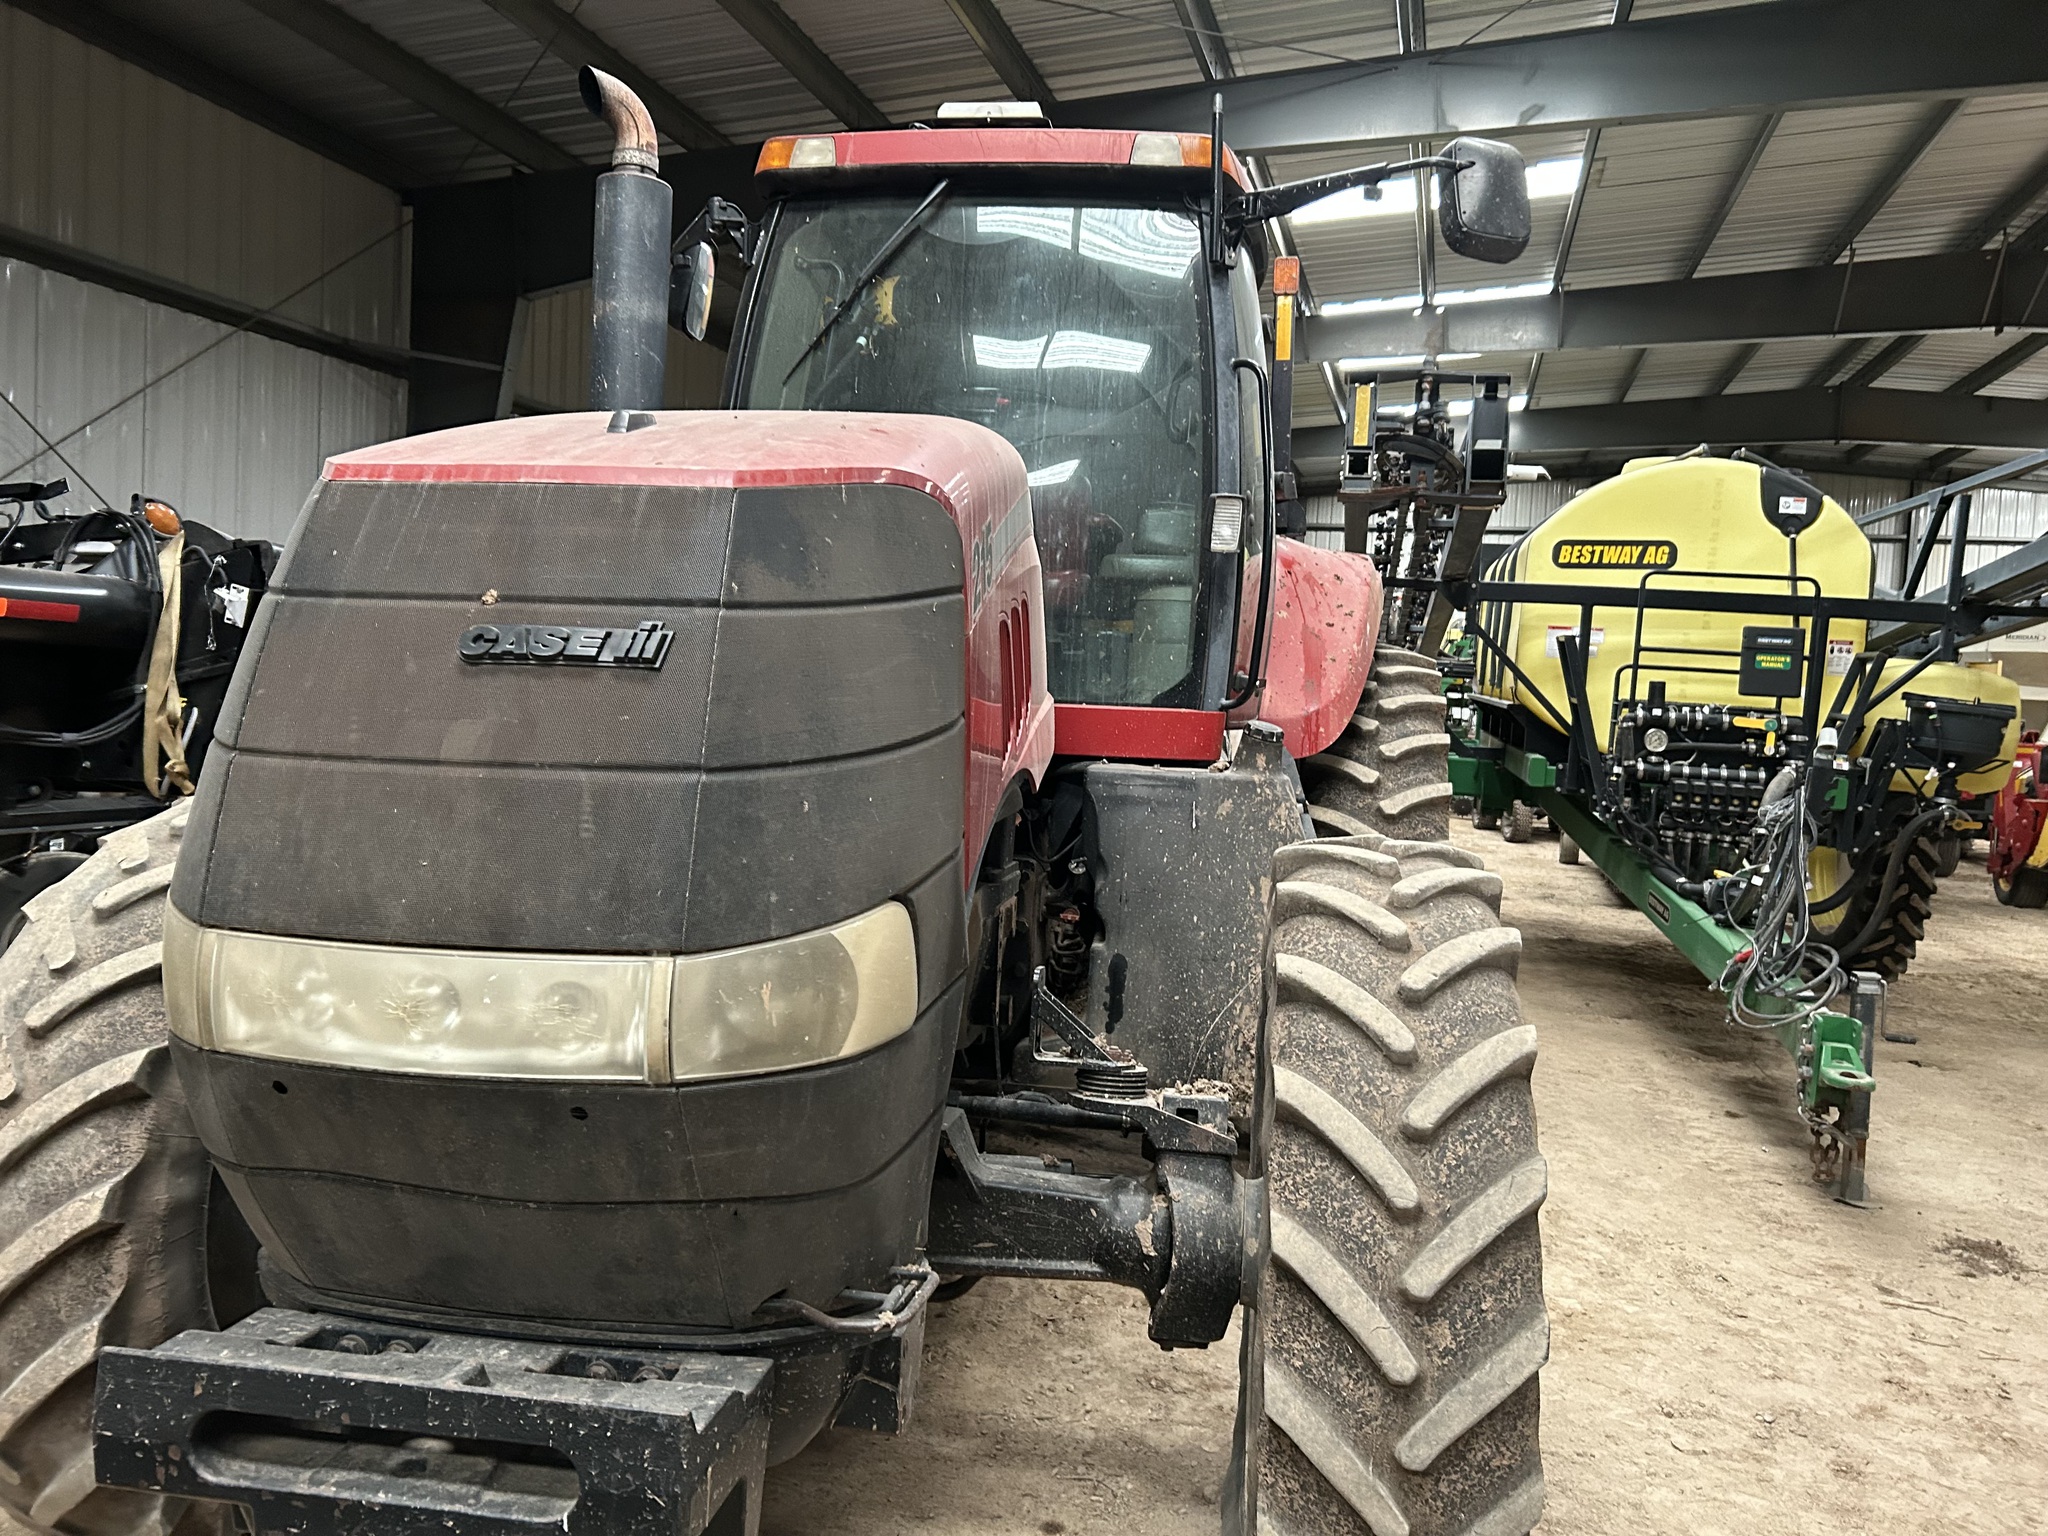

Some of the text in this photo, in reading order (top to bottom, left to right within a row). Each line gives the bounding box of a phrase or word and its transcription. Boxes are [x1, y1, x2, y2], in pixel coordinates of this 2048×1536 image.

[1558, 545, 1670, 564] BESTWAY AG
[459, 625, 603, 658] CASE
[1756, 655, 1790, 663] OPERATOR'S
